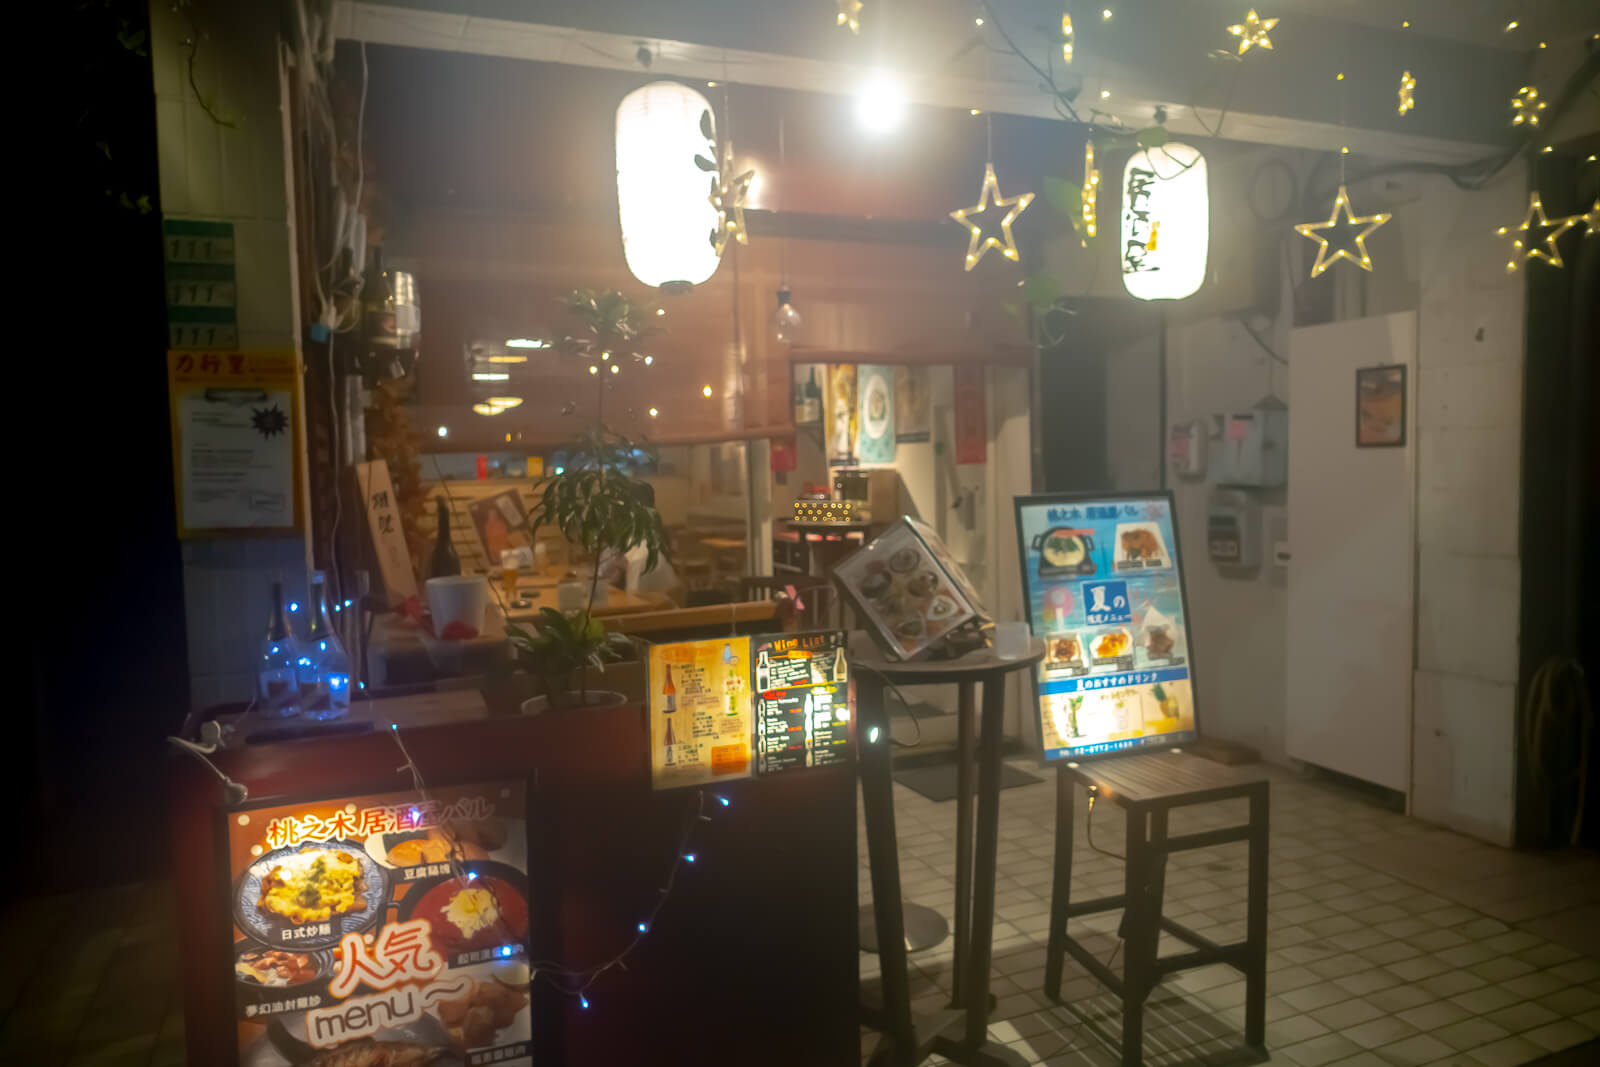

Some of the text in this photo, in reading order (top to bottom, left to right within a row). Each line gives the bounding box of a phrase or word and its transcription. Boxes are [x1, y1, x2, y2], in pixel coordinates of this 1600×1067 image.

[268, 812, 356, 847] 桃之木
[336, 923, 438, 992] 人気
